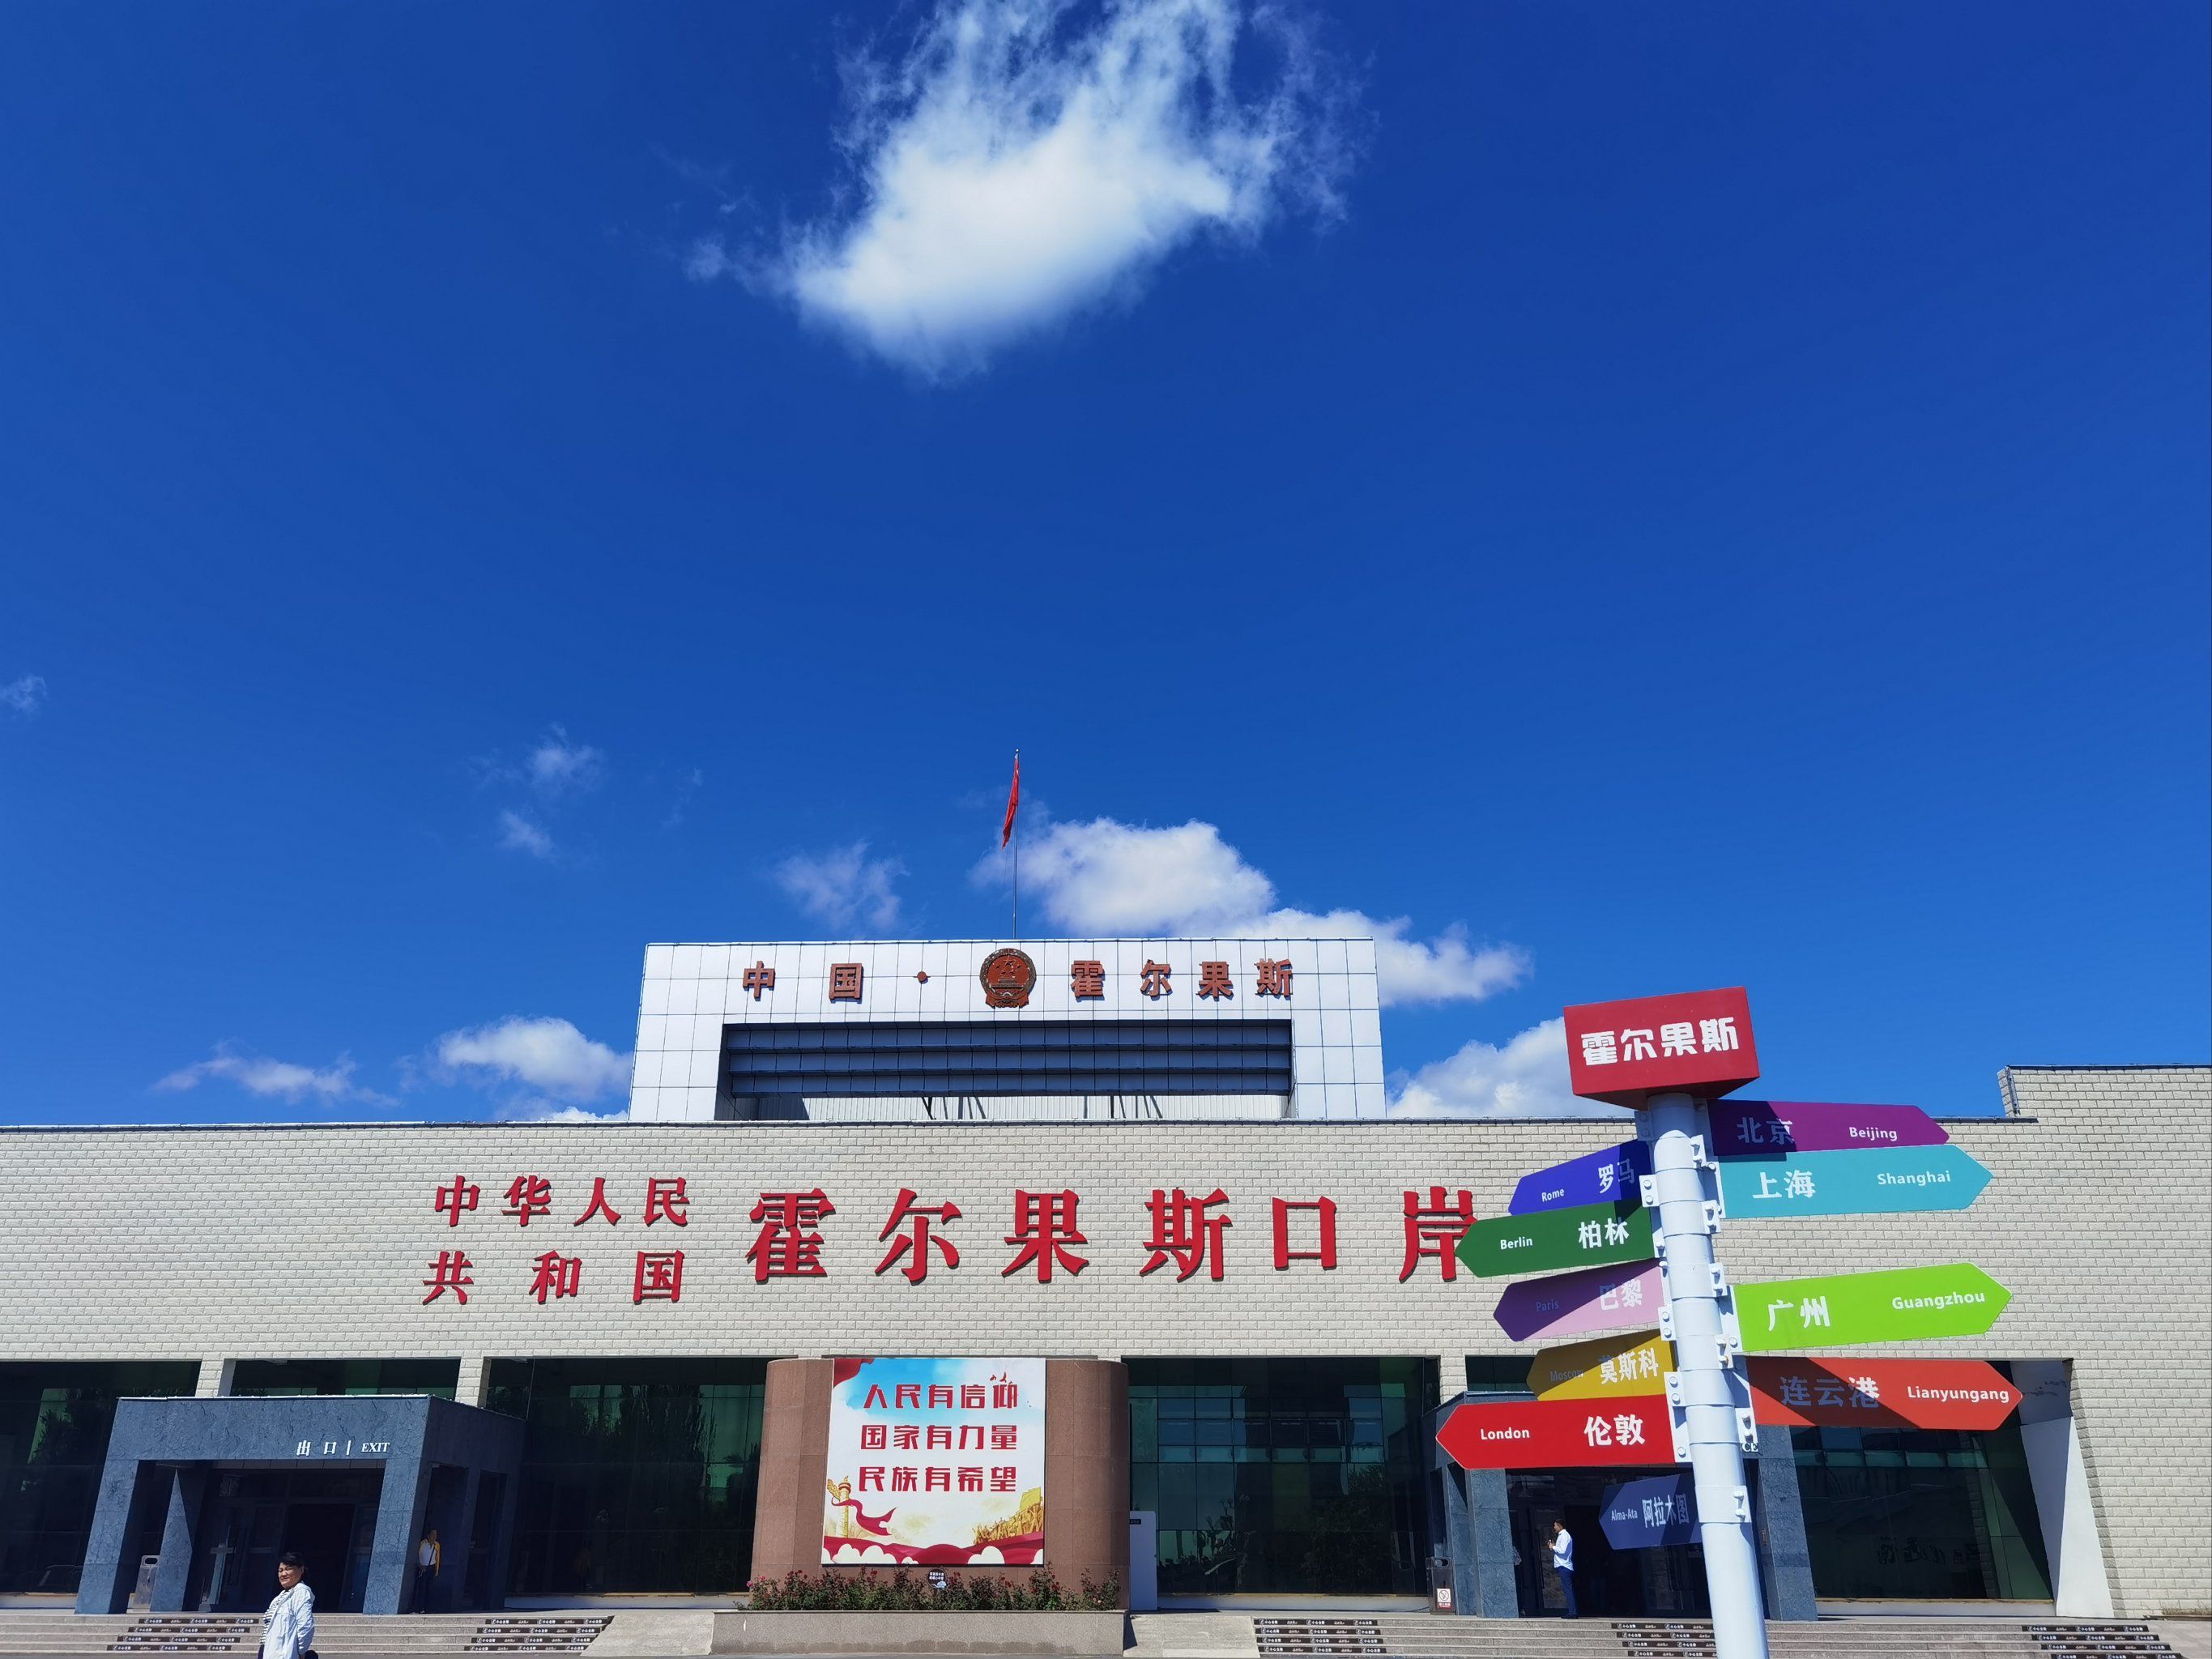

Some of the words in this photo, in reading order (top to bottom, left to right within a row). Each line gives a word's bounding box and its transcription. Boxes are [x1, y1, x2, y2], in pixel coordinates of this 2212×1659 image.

[1581, 1017, 1740, 1067] 霍尔果斯
[1737, 1116, 1795, 1145] 北京
[1848, 1127, 1898, 1142] Beijing
[1541, 1188, 1565, 1202] Rome
[1598, 1158, 1634, 1194] 罗马
[1752, 1169, 1816, 1199] 上海
[1877, 1170, 1951, 1187] Shanghai
[435, 1175, 690, 1227] 中华人民
[746, 1186, 1476, 1284] 霍尔果斯口岸
[1500, 1236, 1533, 1250] Berlin
[1578, 1218, 1630, 1249] 柏林
[422, 1249, 685, 1305] 共和国
[1536, 1299, 1560, 1311] Paris
[1600, 1278, 1643, 1311] 巴黎
[1767, 1295, 1831, 1331] 广州
[1891, 1291, 1985, 1310] Guangzhou
[1549, 1368, 1584, 1382] Moscow
[1598, 1347, 1659, 1385] 莫斯科
[863, 1384, 1018, 1410] 人民有信仰
[1779, 1375, 1881, 1408] 连云港
[1907, 1385, 2010, 1404] Lianyungang
[860, 1424, 1017, 1451] 国家有力量
[1480, 1427, 1530, 1440] London
[1583, 1414, 1646, 1447] 伦敦
[296, 1439, 337, 1456] 出口
[360, 1442, 390, 1452] EXIT
[859, 1466, 1016, 1492] 民族有希望
[1611, 1508, 1638, 1521] Alma-Ata
[1641, 1494, 1690, 1529] 阿拉木图
